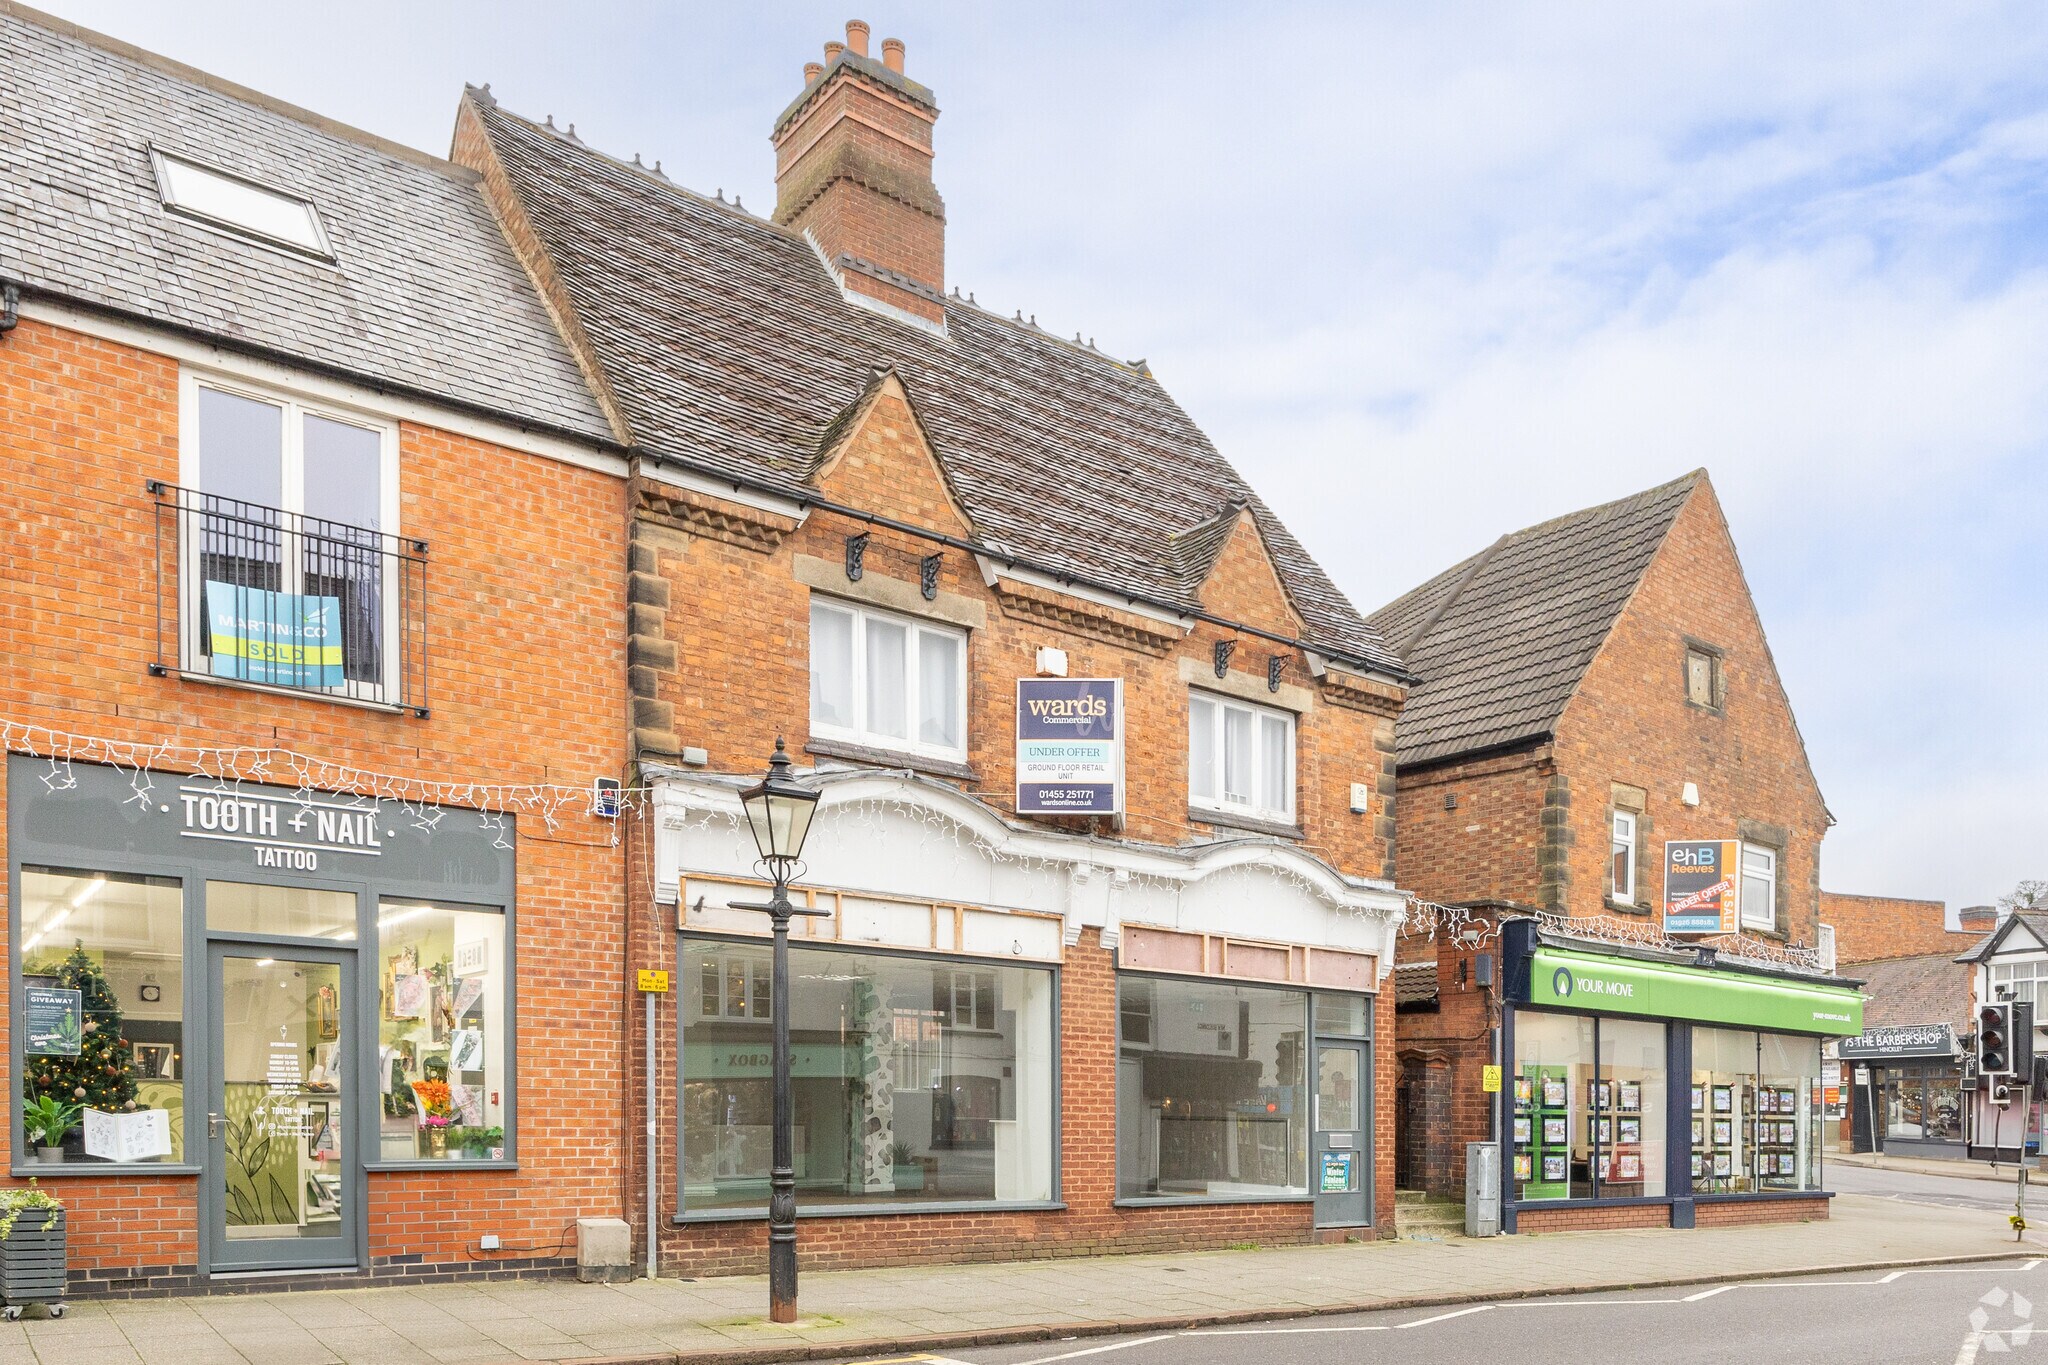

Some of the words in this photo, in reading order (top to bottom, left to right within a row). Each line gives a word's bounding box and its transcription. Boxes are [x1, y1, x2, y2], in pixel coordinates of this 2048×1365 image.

[250, 643, 304, 661] SOLD
[1028, 694, 1107, 716] wards
[1042, 716, 1092, 724] Commercial
[1029, 747, 1065, 757] UNDER
[1066, 748, 1101, 757] OFFER
[1027, 763, 1056, 772] GROUND
[1057, 763, 1080, 772] FLOOR
[1081, 763, 1105, 772] RETAIL
[1058, 772, 1074, 780] UNIT
[1039, 789, 1065, 799] 01455
[1066, 790, 1094, 799] 251771
[180, 794, 278, 837] TOOTH
[317, 810, 381, 847] NAIL
[254, 846, 317, 871] TATTOO
[1671, 848, 1715, 866] ehB
[1671, 864, 1715, 874] Reeves
[1724, 873, 1735, 897] FR
[1670, 894, 1701, 913] UNDER
[1701, 880, 1730, 899] OFFER
[1670, 919, 1691, 927] 01926
[1723, 900, 1734, 930] SALE
[1576, 977, 1604, 994] YOUR
[1605, 981, 1634, 997] MOVE
[1856, 1036, 1875, 1047] THE
[1876, 1034, 1913, 1046] BARBER
[1913, 1032, 1942, 1045] SHOP
